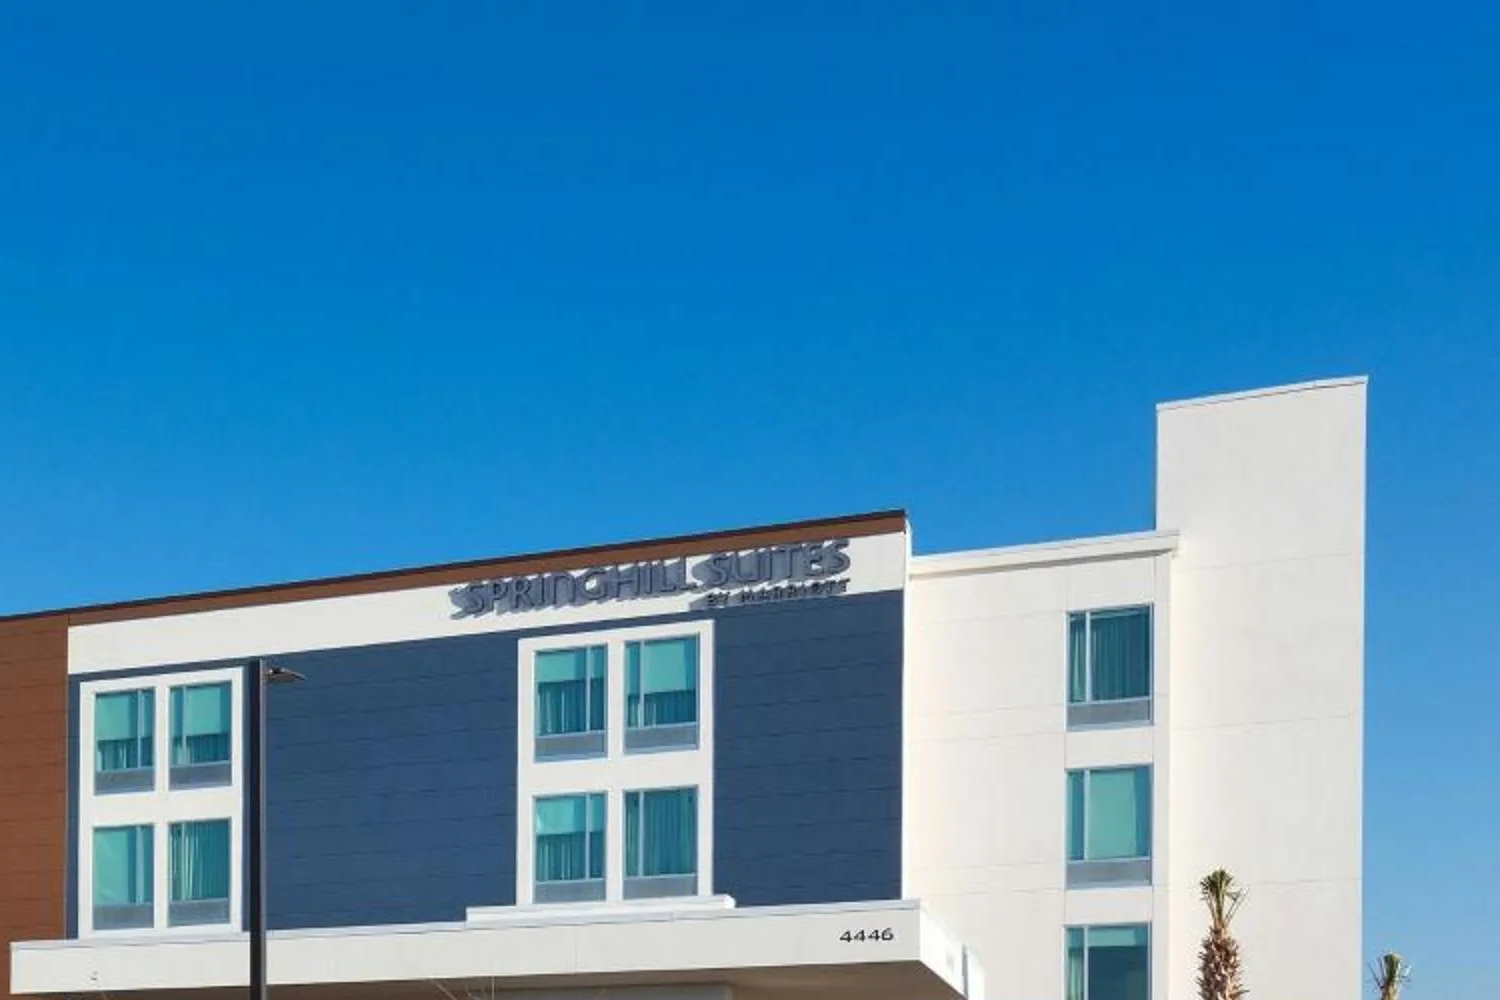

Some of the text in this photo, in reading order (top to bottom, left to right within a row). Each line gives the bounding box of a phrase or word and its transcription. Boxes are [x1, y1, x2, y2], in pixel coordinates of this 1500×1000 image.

[466, 538, 851, 615] SPRINGHILL SUITES
[839, 927, 894, 943] 4446
